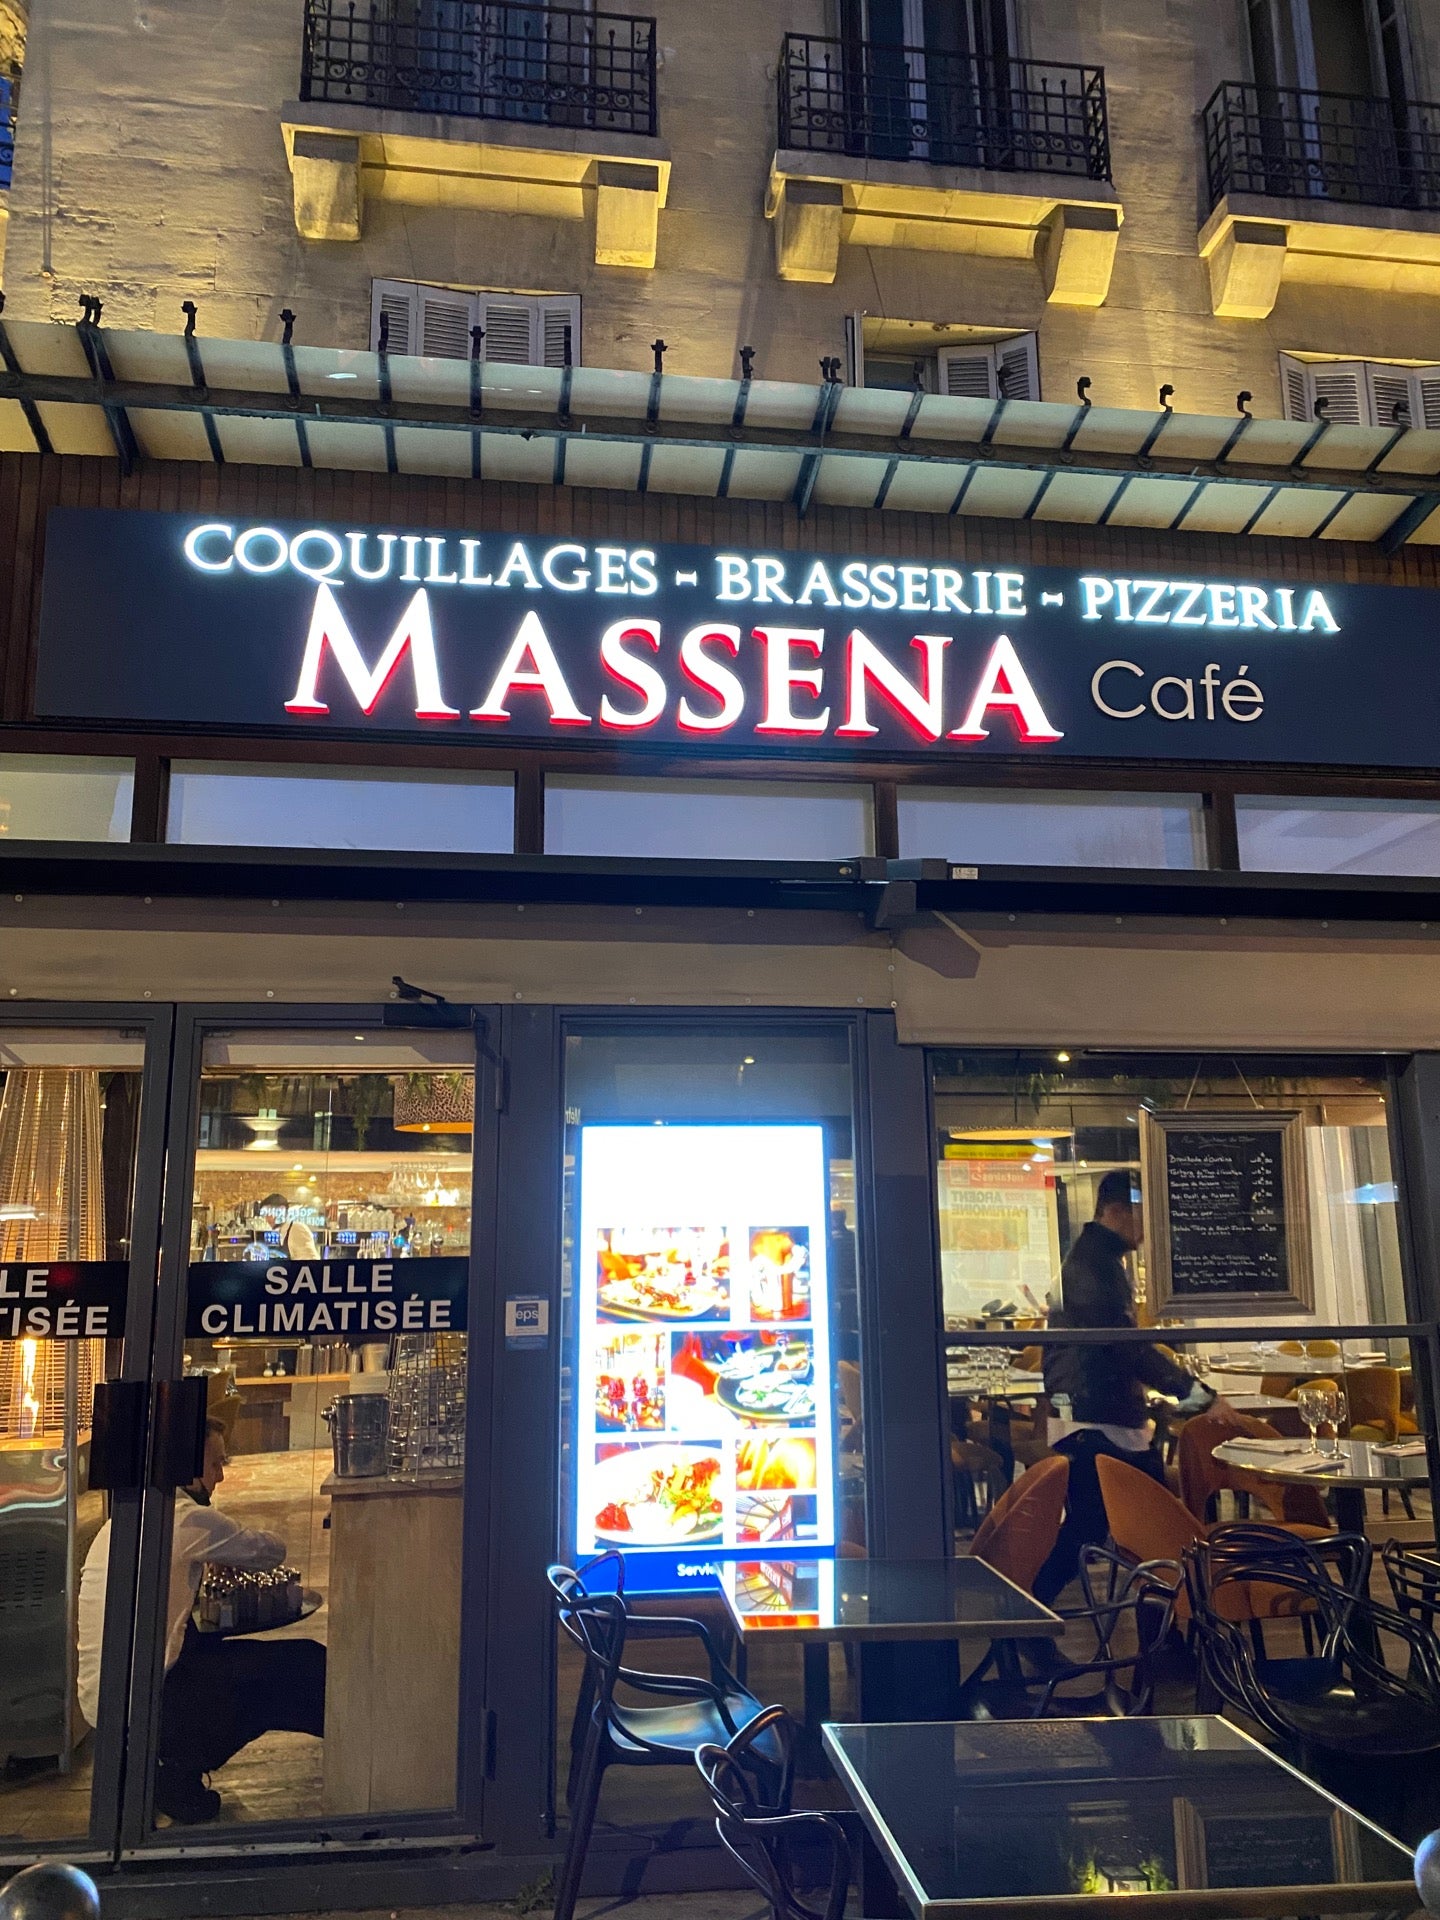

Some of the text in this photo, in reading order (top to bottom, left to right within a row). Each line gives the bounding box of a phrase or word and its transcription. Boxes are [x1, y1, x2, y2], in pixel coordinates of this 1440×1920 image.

[184, 524, 659, 597] COQUILLAGES
[715, 555, 1028, 617] BRASSERIE
[1080, 577, 1341, 632] PIZZERIA
[284, 583, 1065, 742] MASSENA
[1091, 660, 1265, 722] Café
[264, 1264, 394, 1295] SALLE
[201, 1293, 452, 1334] CLIMATISÉE
[516, 1309, 539, 1323] eps
